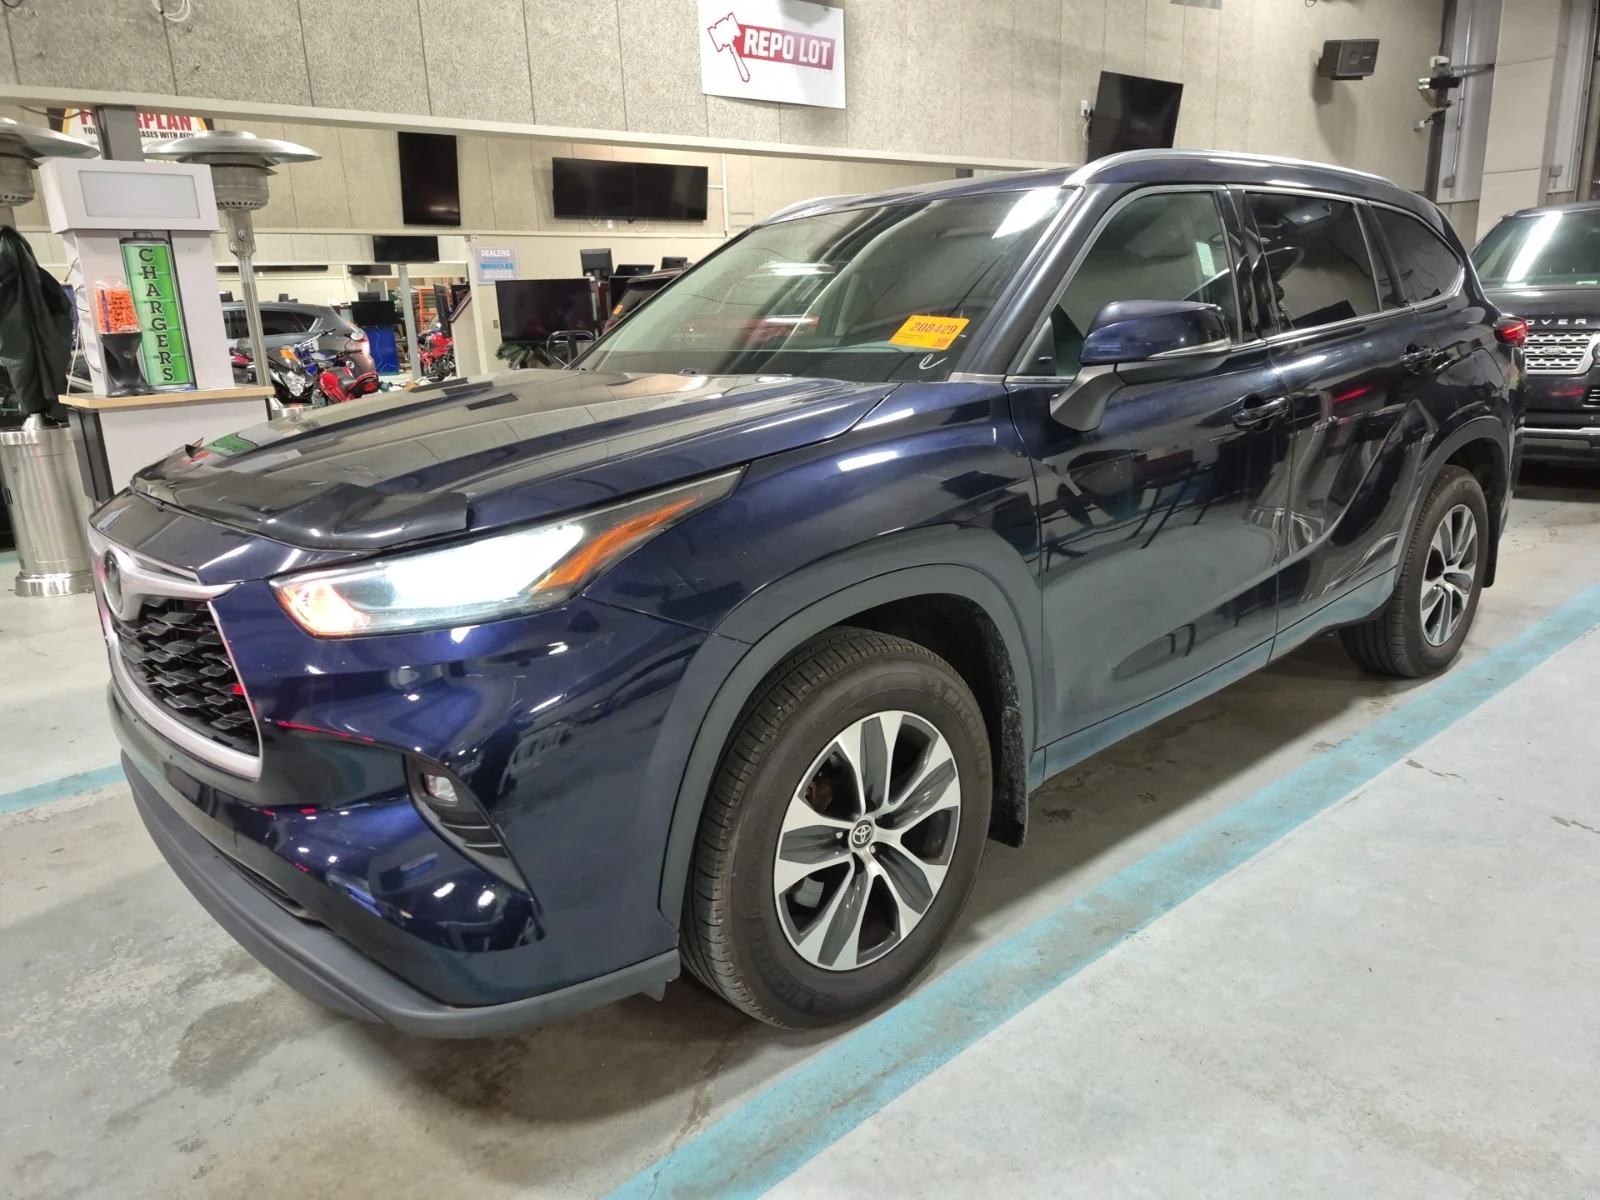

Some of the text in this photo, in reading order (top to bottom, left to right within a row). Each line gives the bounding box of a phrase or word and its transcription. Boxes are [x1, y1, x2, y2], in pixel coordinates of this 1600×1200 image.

[744, 28, 831, 66] REPO LOT
[480, 249, 510, 257] DEALERS
[138, 247, 174, 382] CHARGERS
[909, 322, 958, 335] 208429
[1525, 318, 1587, 326] OVER
